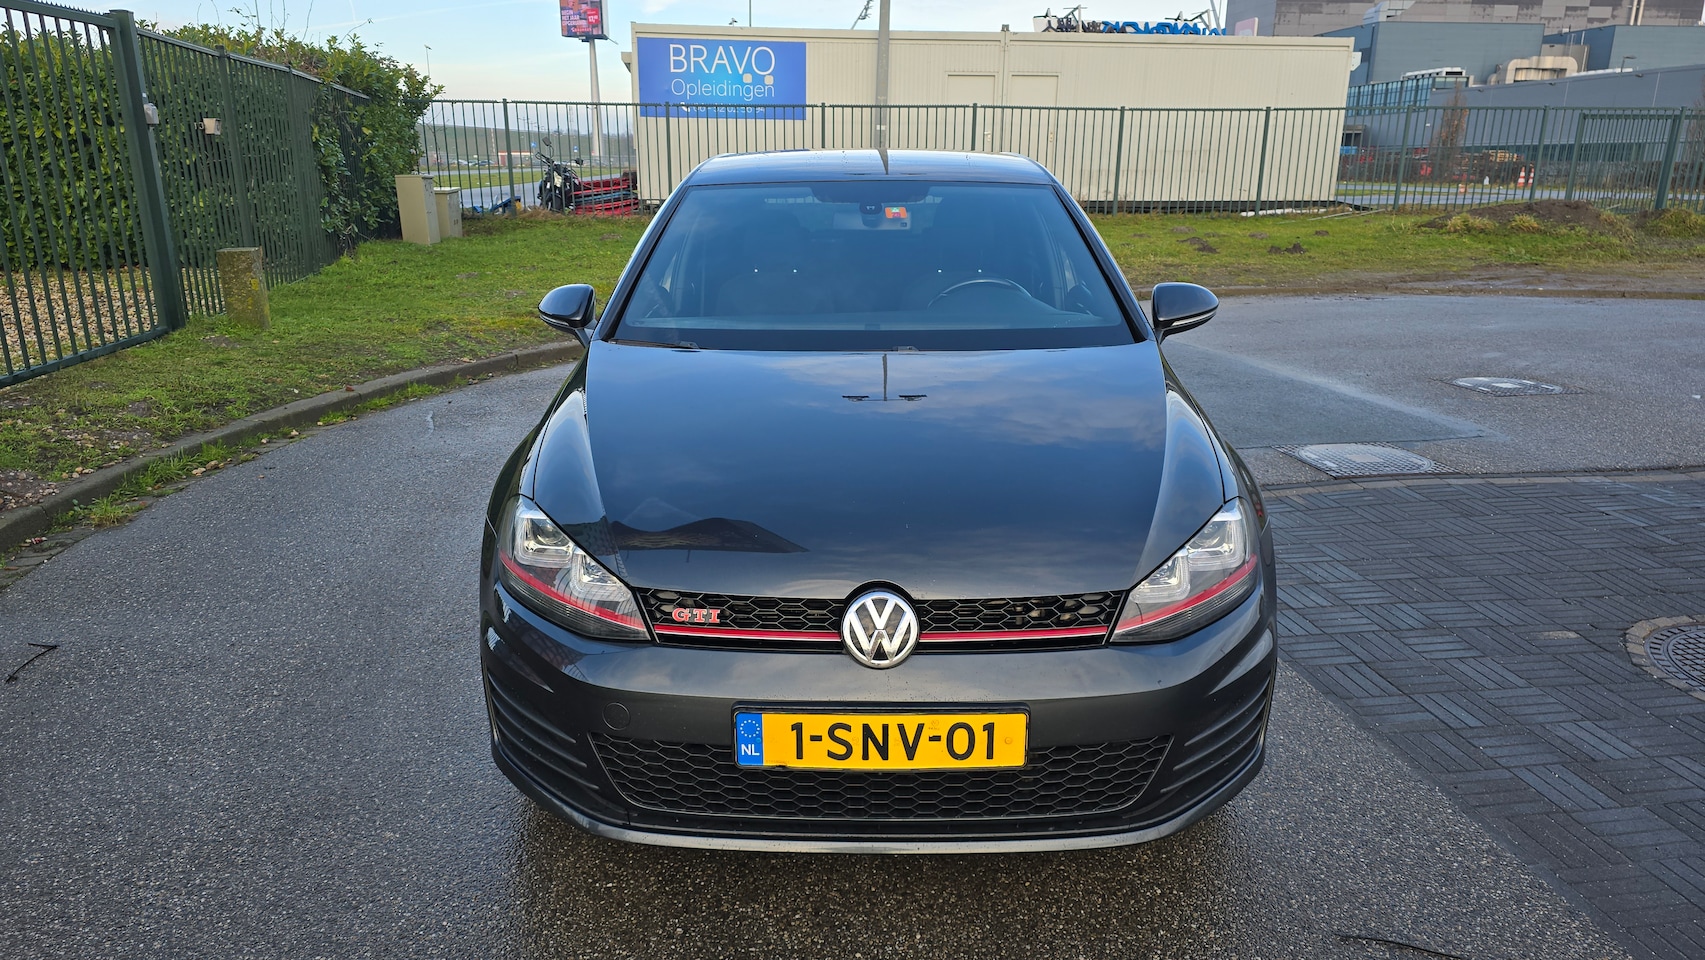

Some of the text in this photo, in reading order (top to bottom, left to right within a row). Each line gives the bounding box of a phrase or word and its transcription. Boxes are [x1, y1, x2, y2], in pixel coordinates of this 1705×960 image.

[669, 44, 775, 75] BRAVO
[671, 78, 775, 101] Opleidingen
[672, 607, 720, 624] GTI
[741, 744, 760, 756] NL
[791, 722, 995, 761] 1-SNV-01
